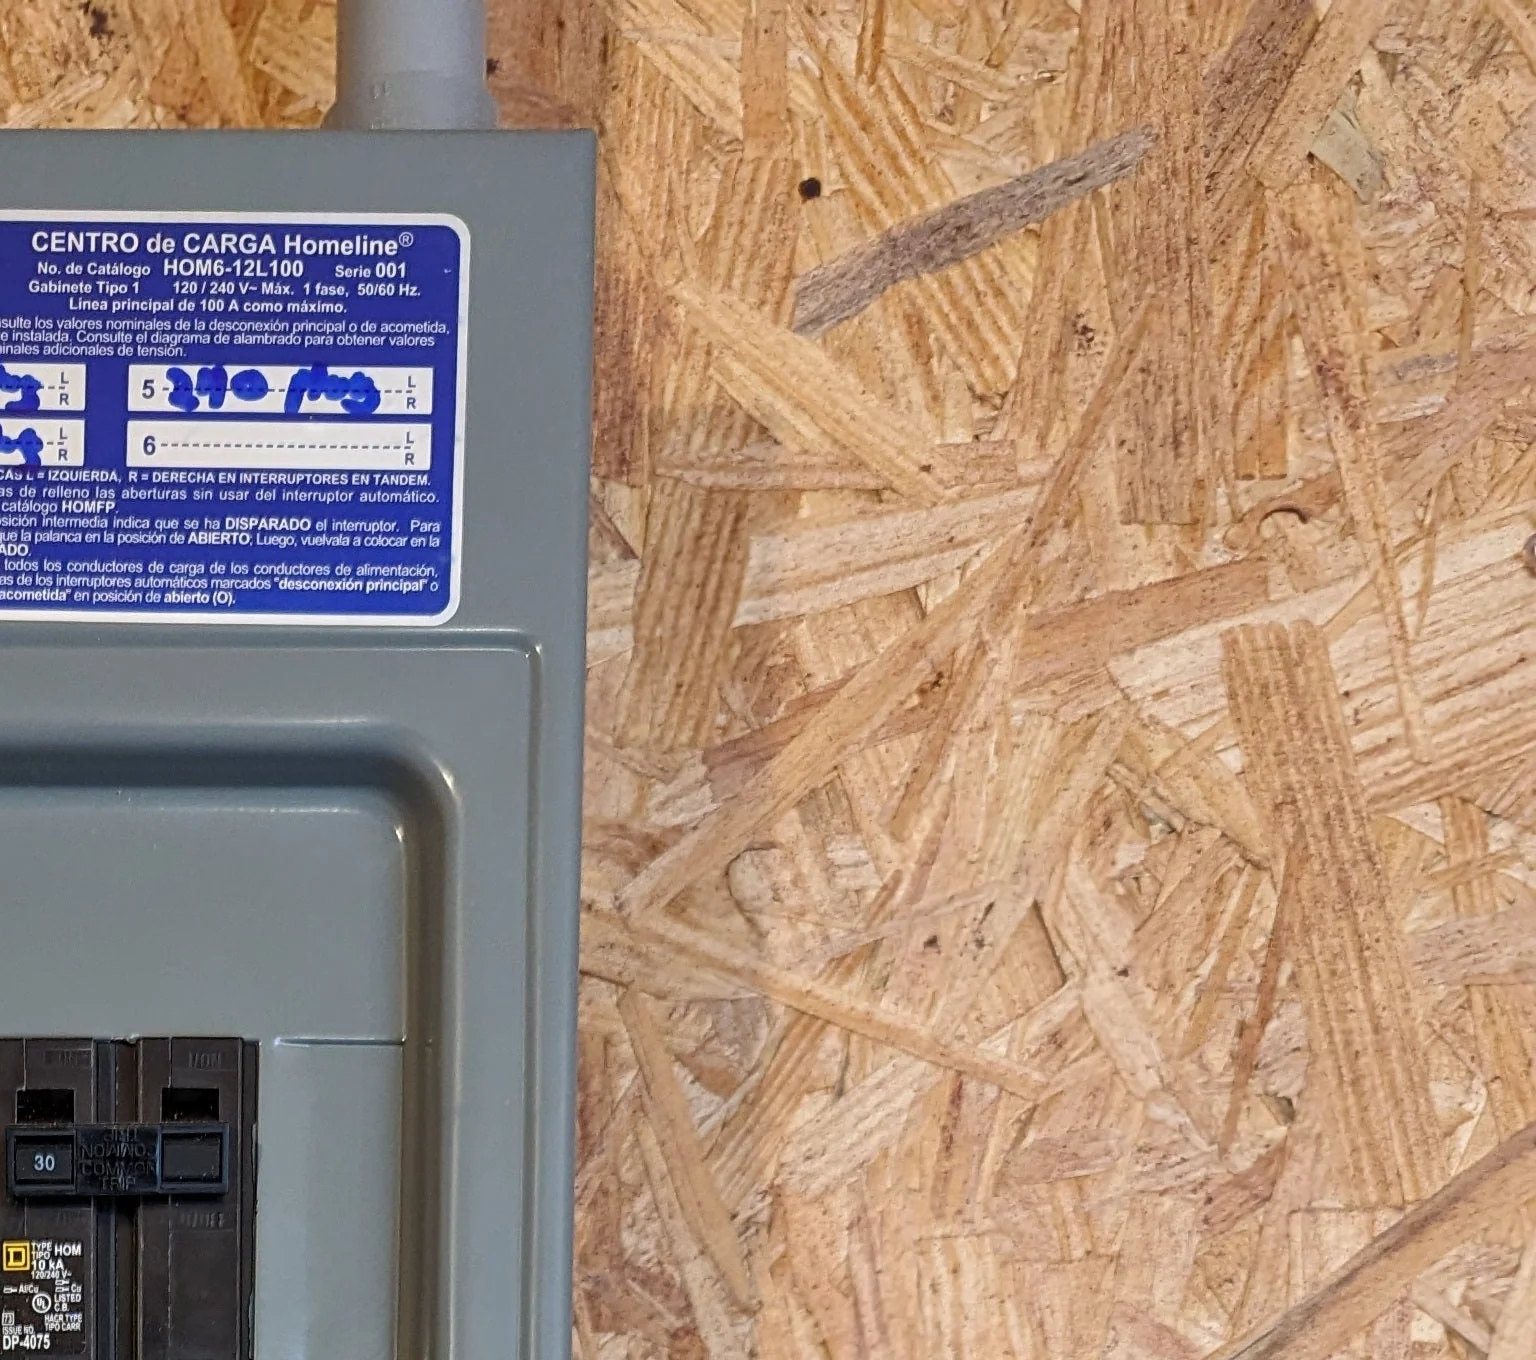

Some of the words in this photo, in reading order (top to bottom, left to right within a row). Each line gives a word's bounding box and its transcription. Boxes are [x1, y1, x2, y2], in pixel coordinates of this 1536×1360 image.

[30, 231, 139, 252] CENTRO
[145, 232, 176, 253] de
[182, 232, 276, 254] CARGA
[36, 261, 62, 274] No.
[64, 261, 83, 274] de
[86, 261, 151, 278] Catálogo
[162, 258, 304, 277] HOM6-12L100
[334, 264, 372, 278] Serie
[374, 262, 406, 278] 001
[68, 297, 108, 310] Línea
[111, 297, 174, 314] principal
[177, 298, 196, 311] de
[199, 298, 225, 311] 100
[227, 298, 240, 311] A
[242, 302, 284, 312] como
[286, 299, 347, 313] máximo.
[142, 380, 155, 399] 5
[143, 435, 156, 455] 6
[34, 1155, 56, 1172] 30
[54, 1244, 82, 1256] HOM
[31, 1260, 44, 1271] 10
[48, 1260, 65, 1271] kA
[2, 1334, 51, 1350] DP-4075
